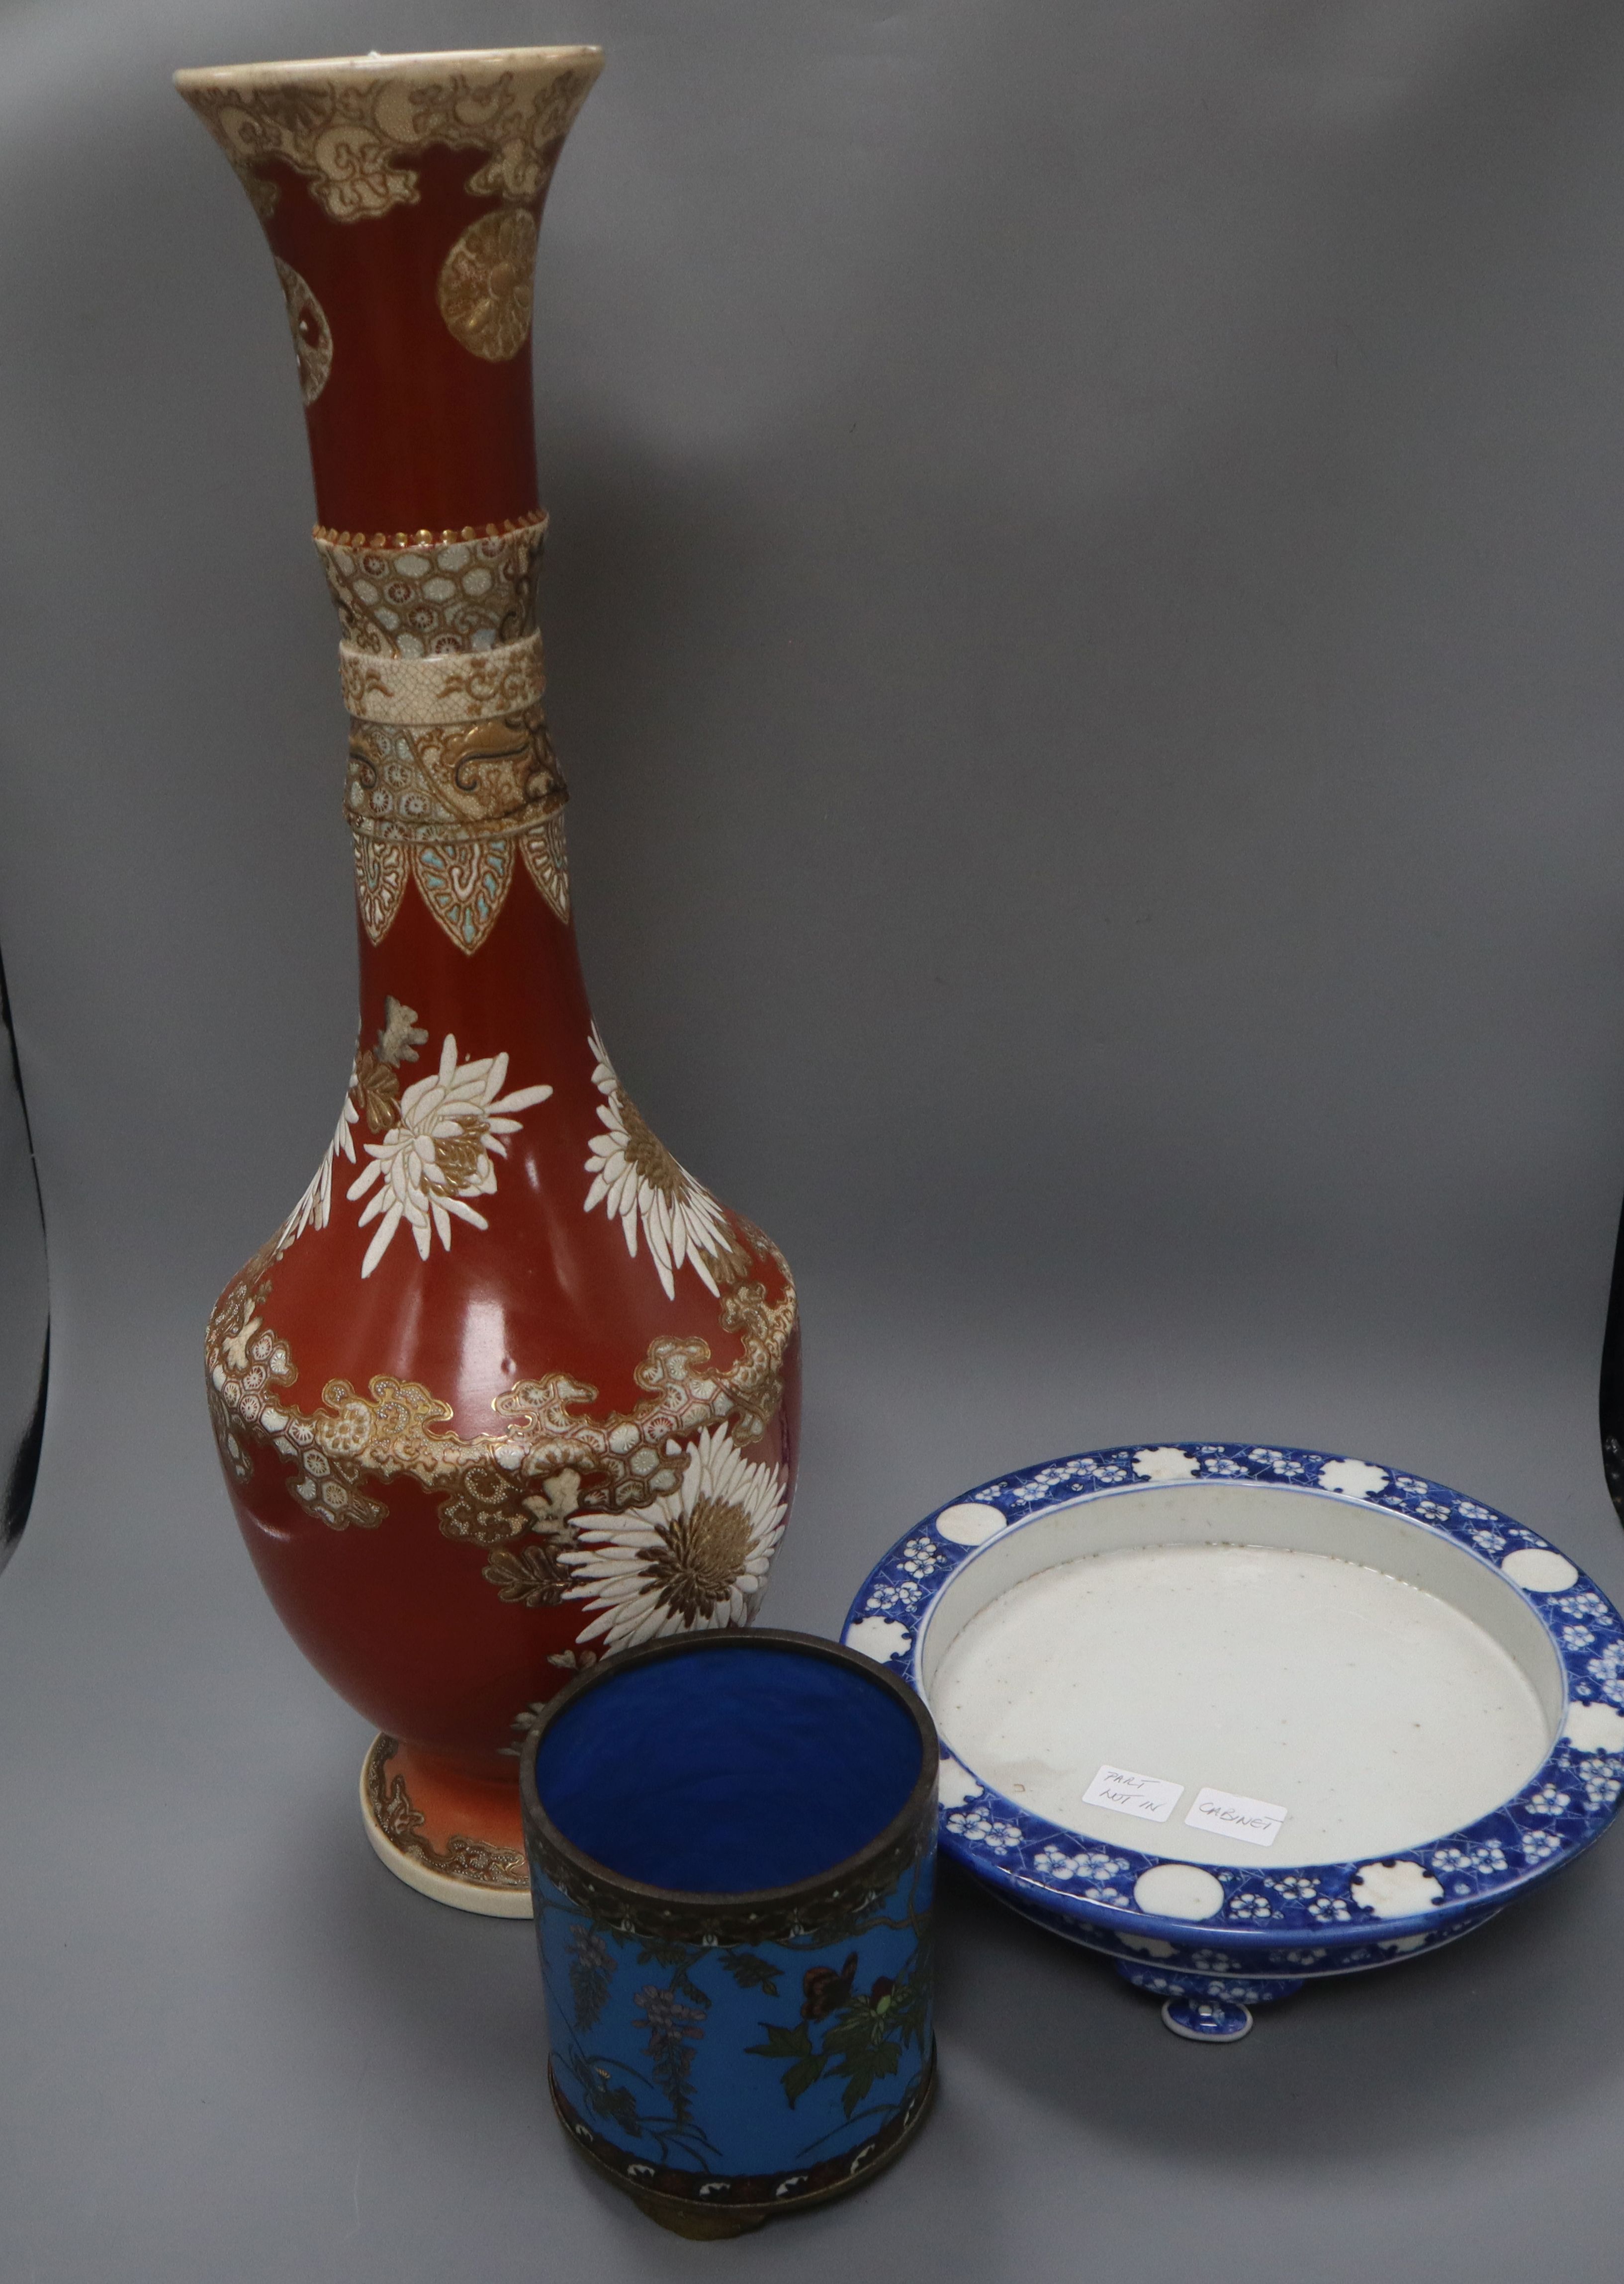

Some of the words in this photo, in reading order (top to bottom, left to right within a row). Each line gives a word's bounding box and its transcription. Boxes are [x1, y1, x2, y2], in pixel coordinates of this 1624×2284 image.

[1103, 1771, 1160, 1789] PART
[1099, 1789, 1145, 1805] NOT
[1139, 1801, 1167, 1812] IN
[1199, 1802, 1284, 1830] CABINET
